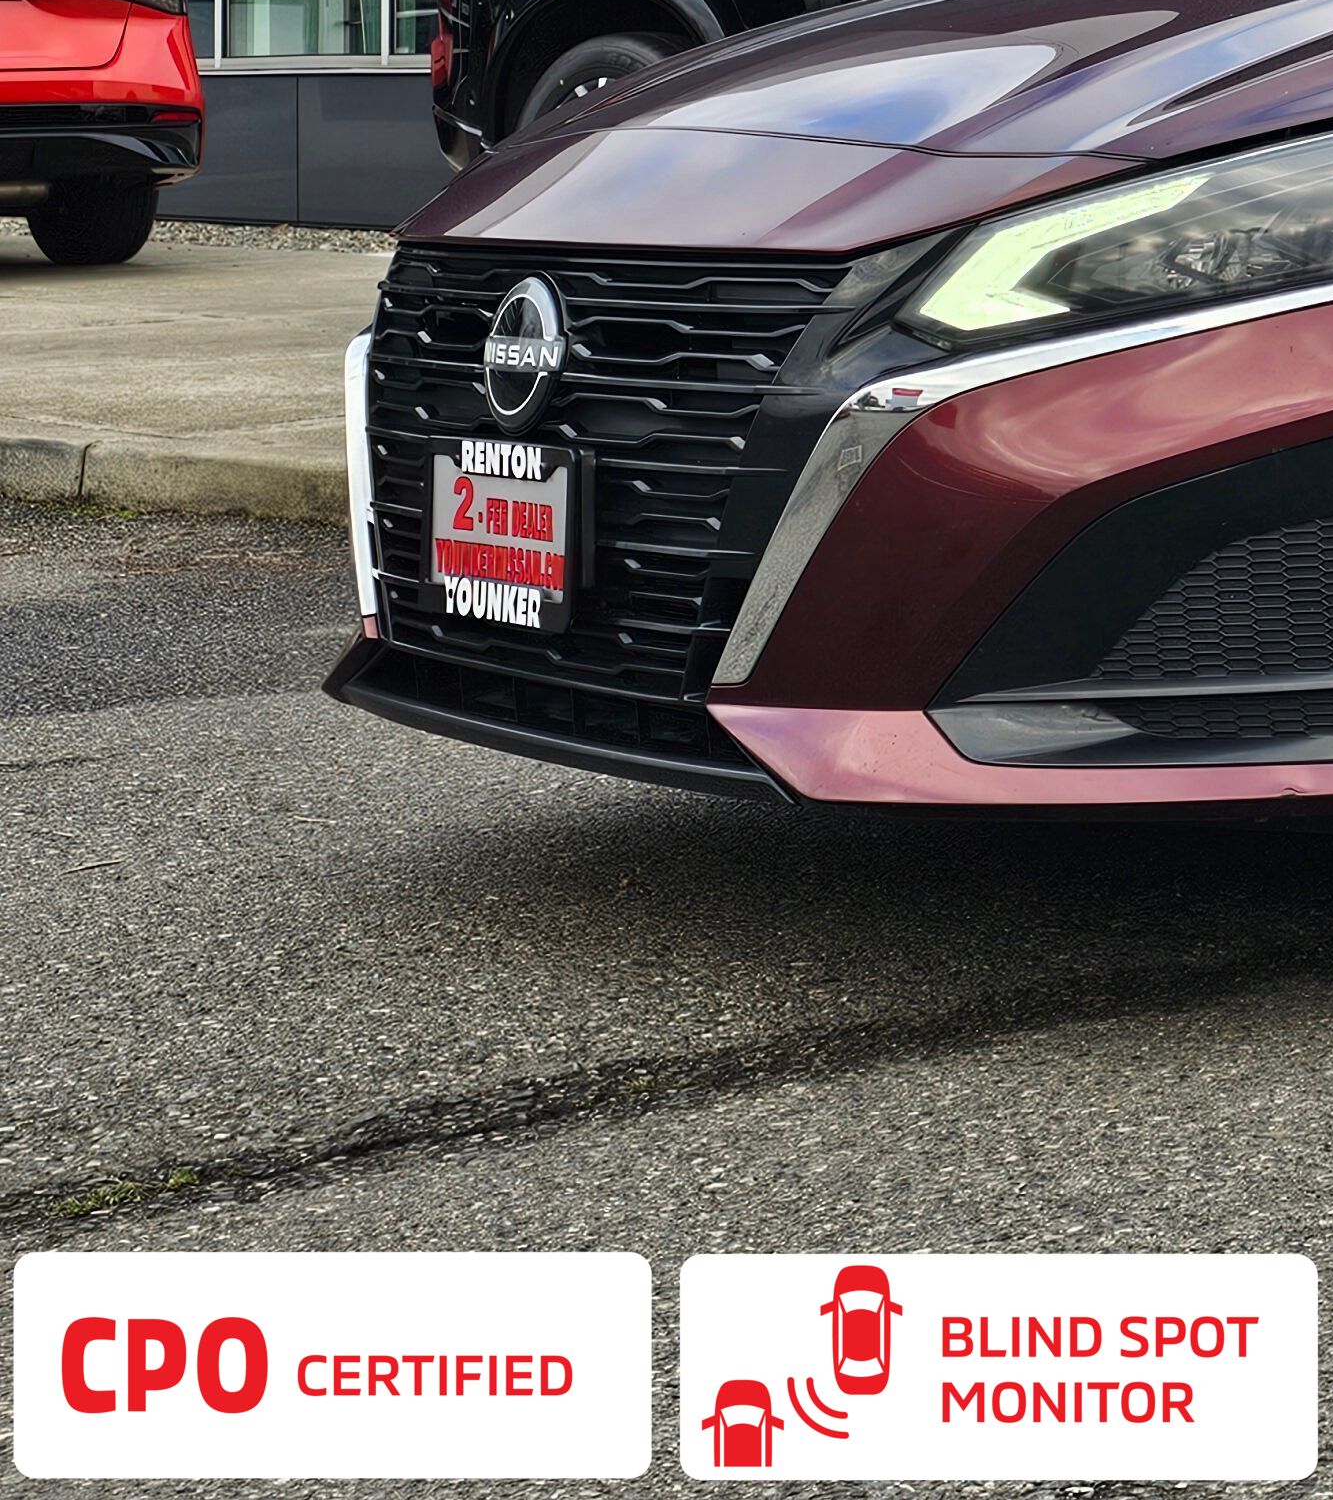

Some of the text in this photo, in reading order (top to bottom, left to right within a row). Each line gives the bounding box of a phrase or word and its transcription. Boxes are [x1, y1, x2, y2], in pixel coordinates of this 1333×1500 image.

[461, 440, 542, 481] RENTON
[512, 501, 553, 542] DEALER
[444, 575, 541, 628] YOUNKER
